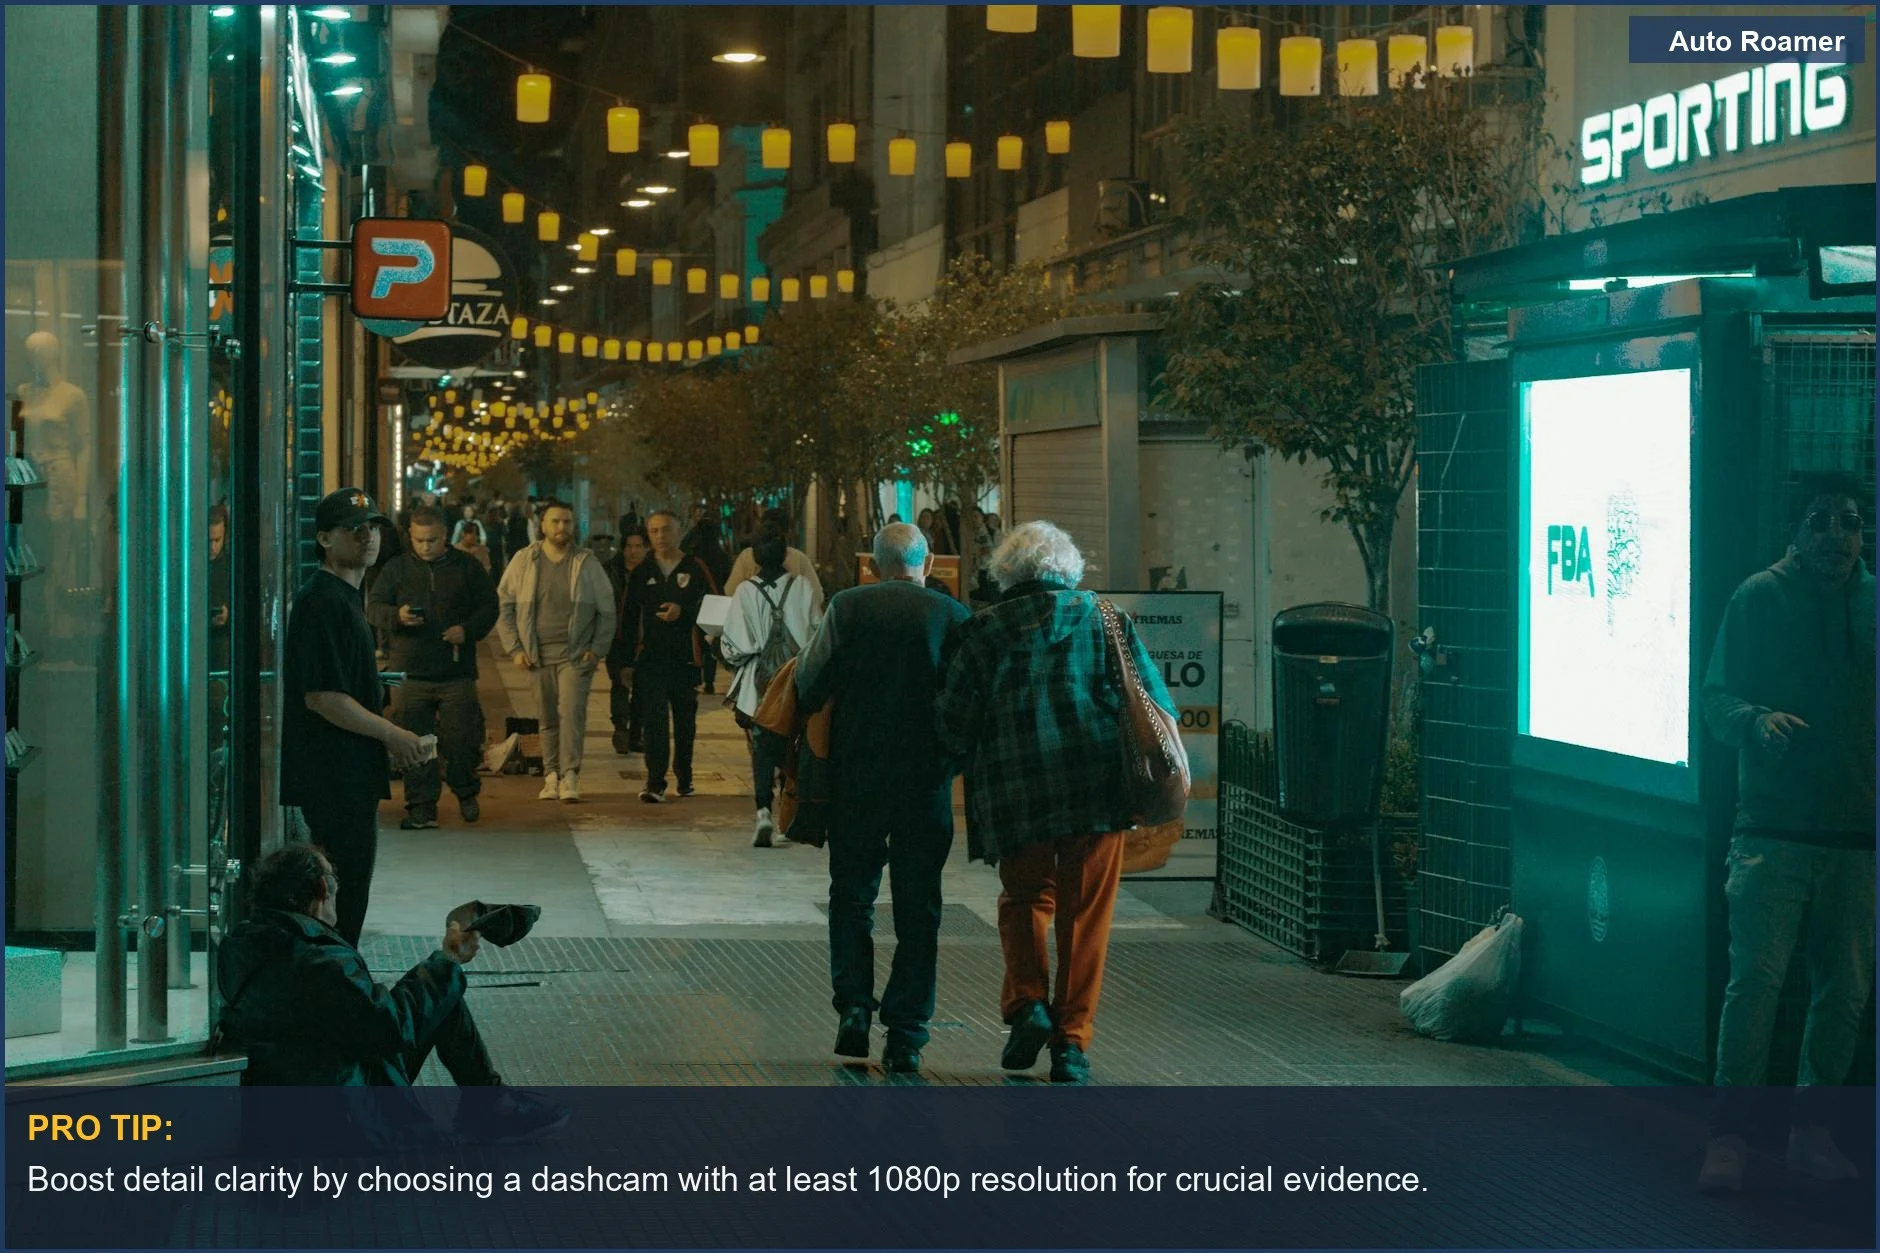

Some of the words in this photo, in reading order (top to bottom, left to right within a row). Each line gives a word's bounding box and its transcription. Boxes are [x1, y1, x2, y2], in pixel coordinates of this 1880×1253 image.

[1581, 55, 1849, 185] SPORTING
[370, 237, 435, 299] P
[428, 302, 510, 325] TAZA
[1188, 650, 1204, 660] DE
[1164, 661, 1206, 688] LO
[1181, 828, 1220, 840] EMA
